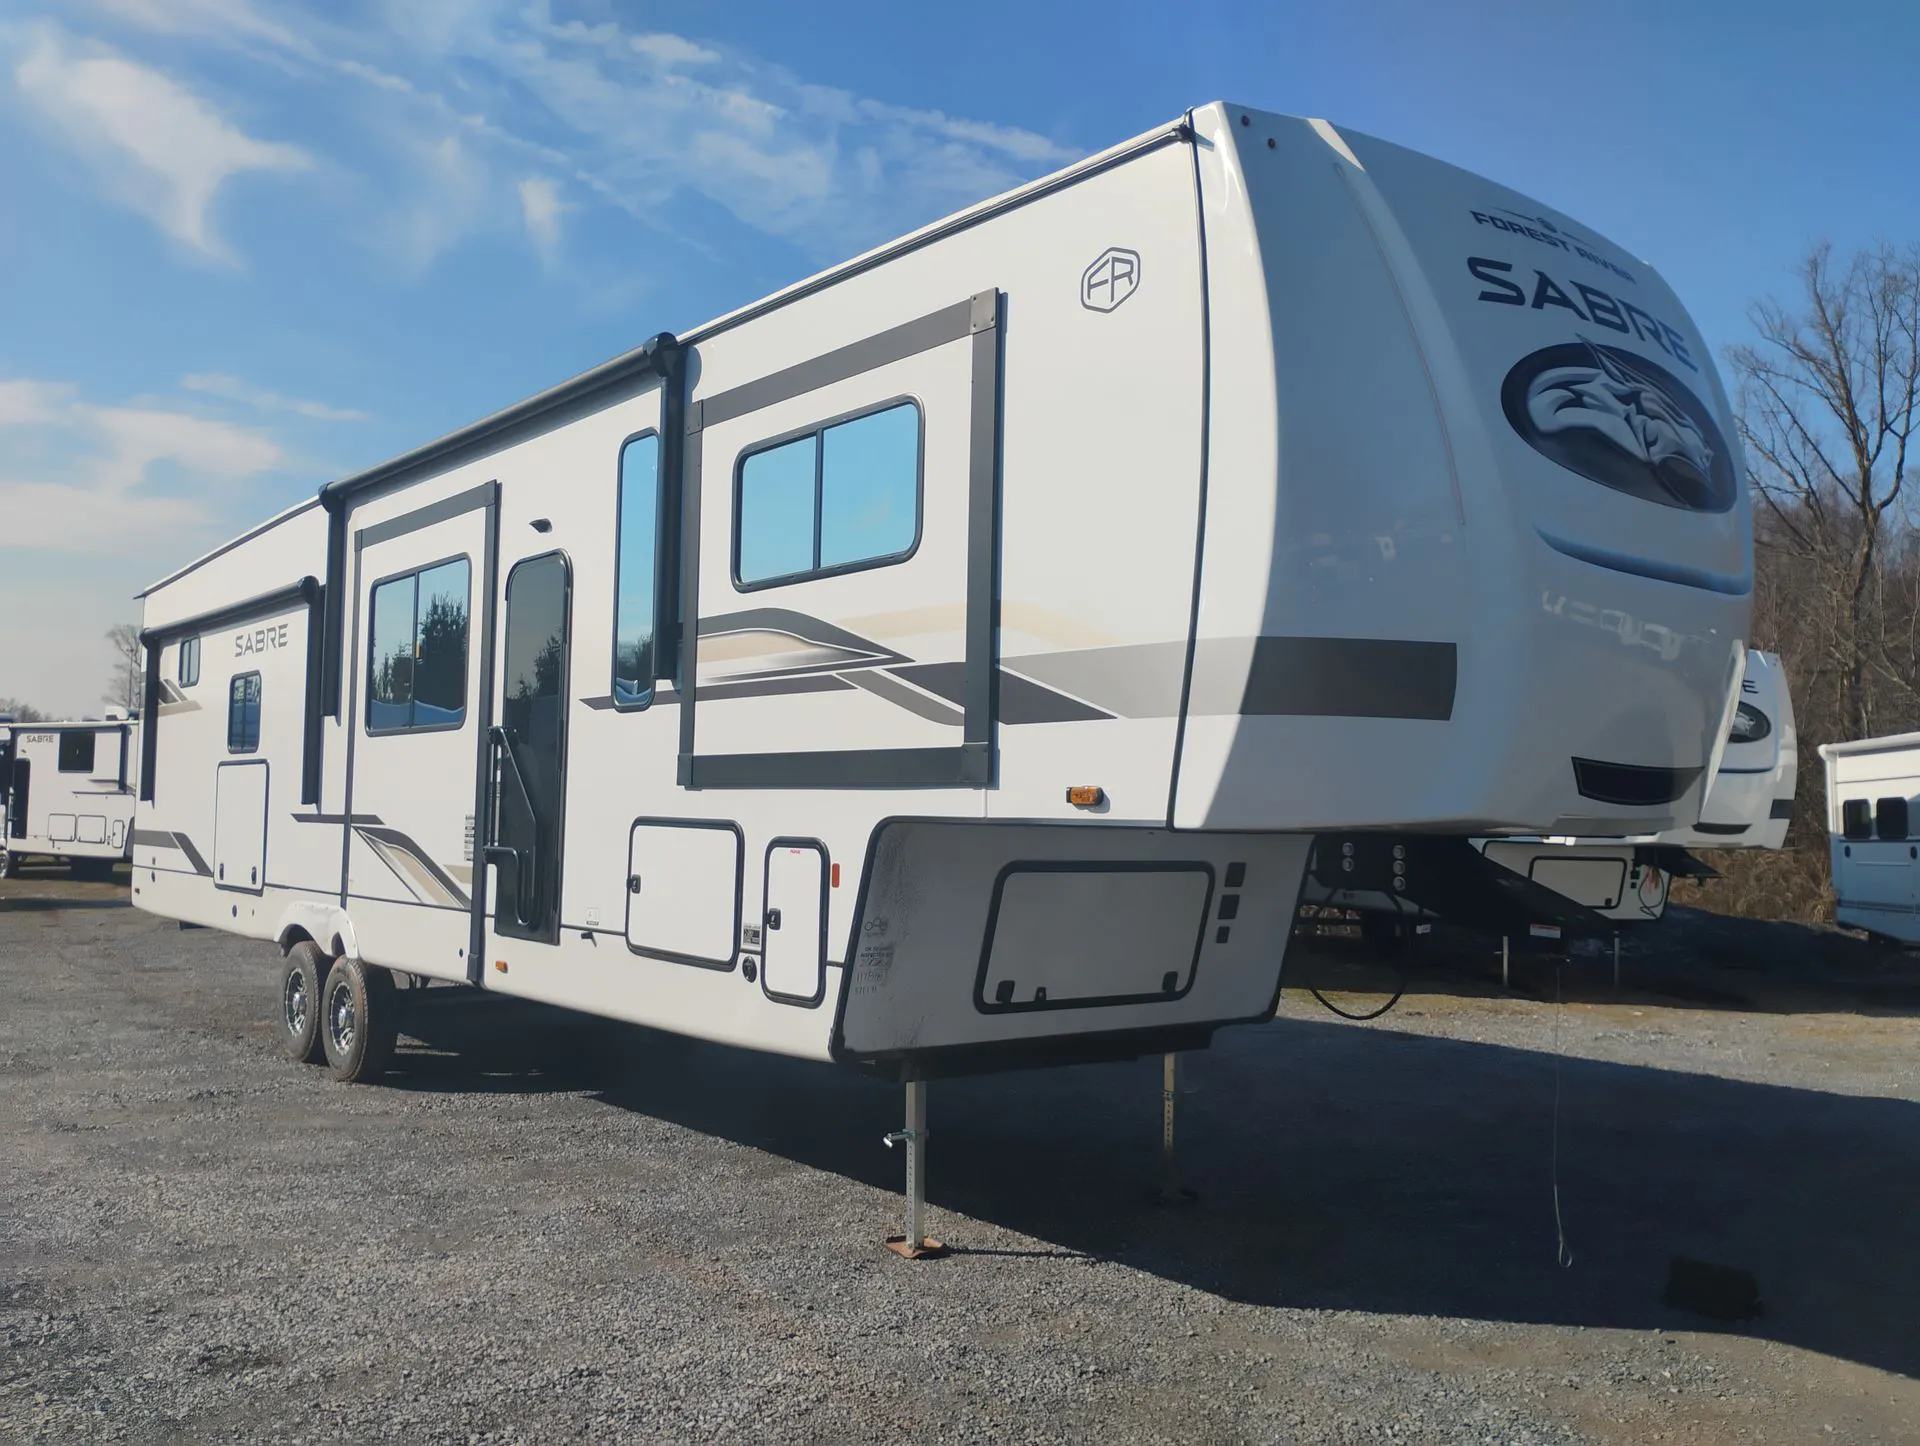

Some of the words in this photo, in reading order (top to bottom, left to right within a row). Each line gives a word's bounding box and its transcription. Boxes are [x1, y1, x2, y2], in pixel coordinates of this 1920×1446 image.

[1470, 210, 1570, 251] FOREST
[1467, 256, 1698, 373] SABRE
[235, 623, 288, 657] SABRE
[26, 734, 55, 743] SABRE
